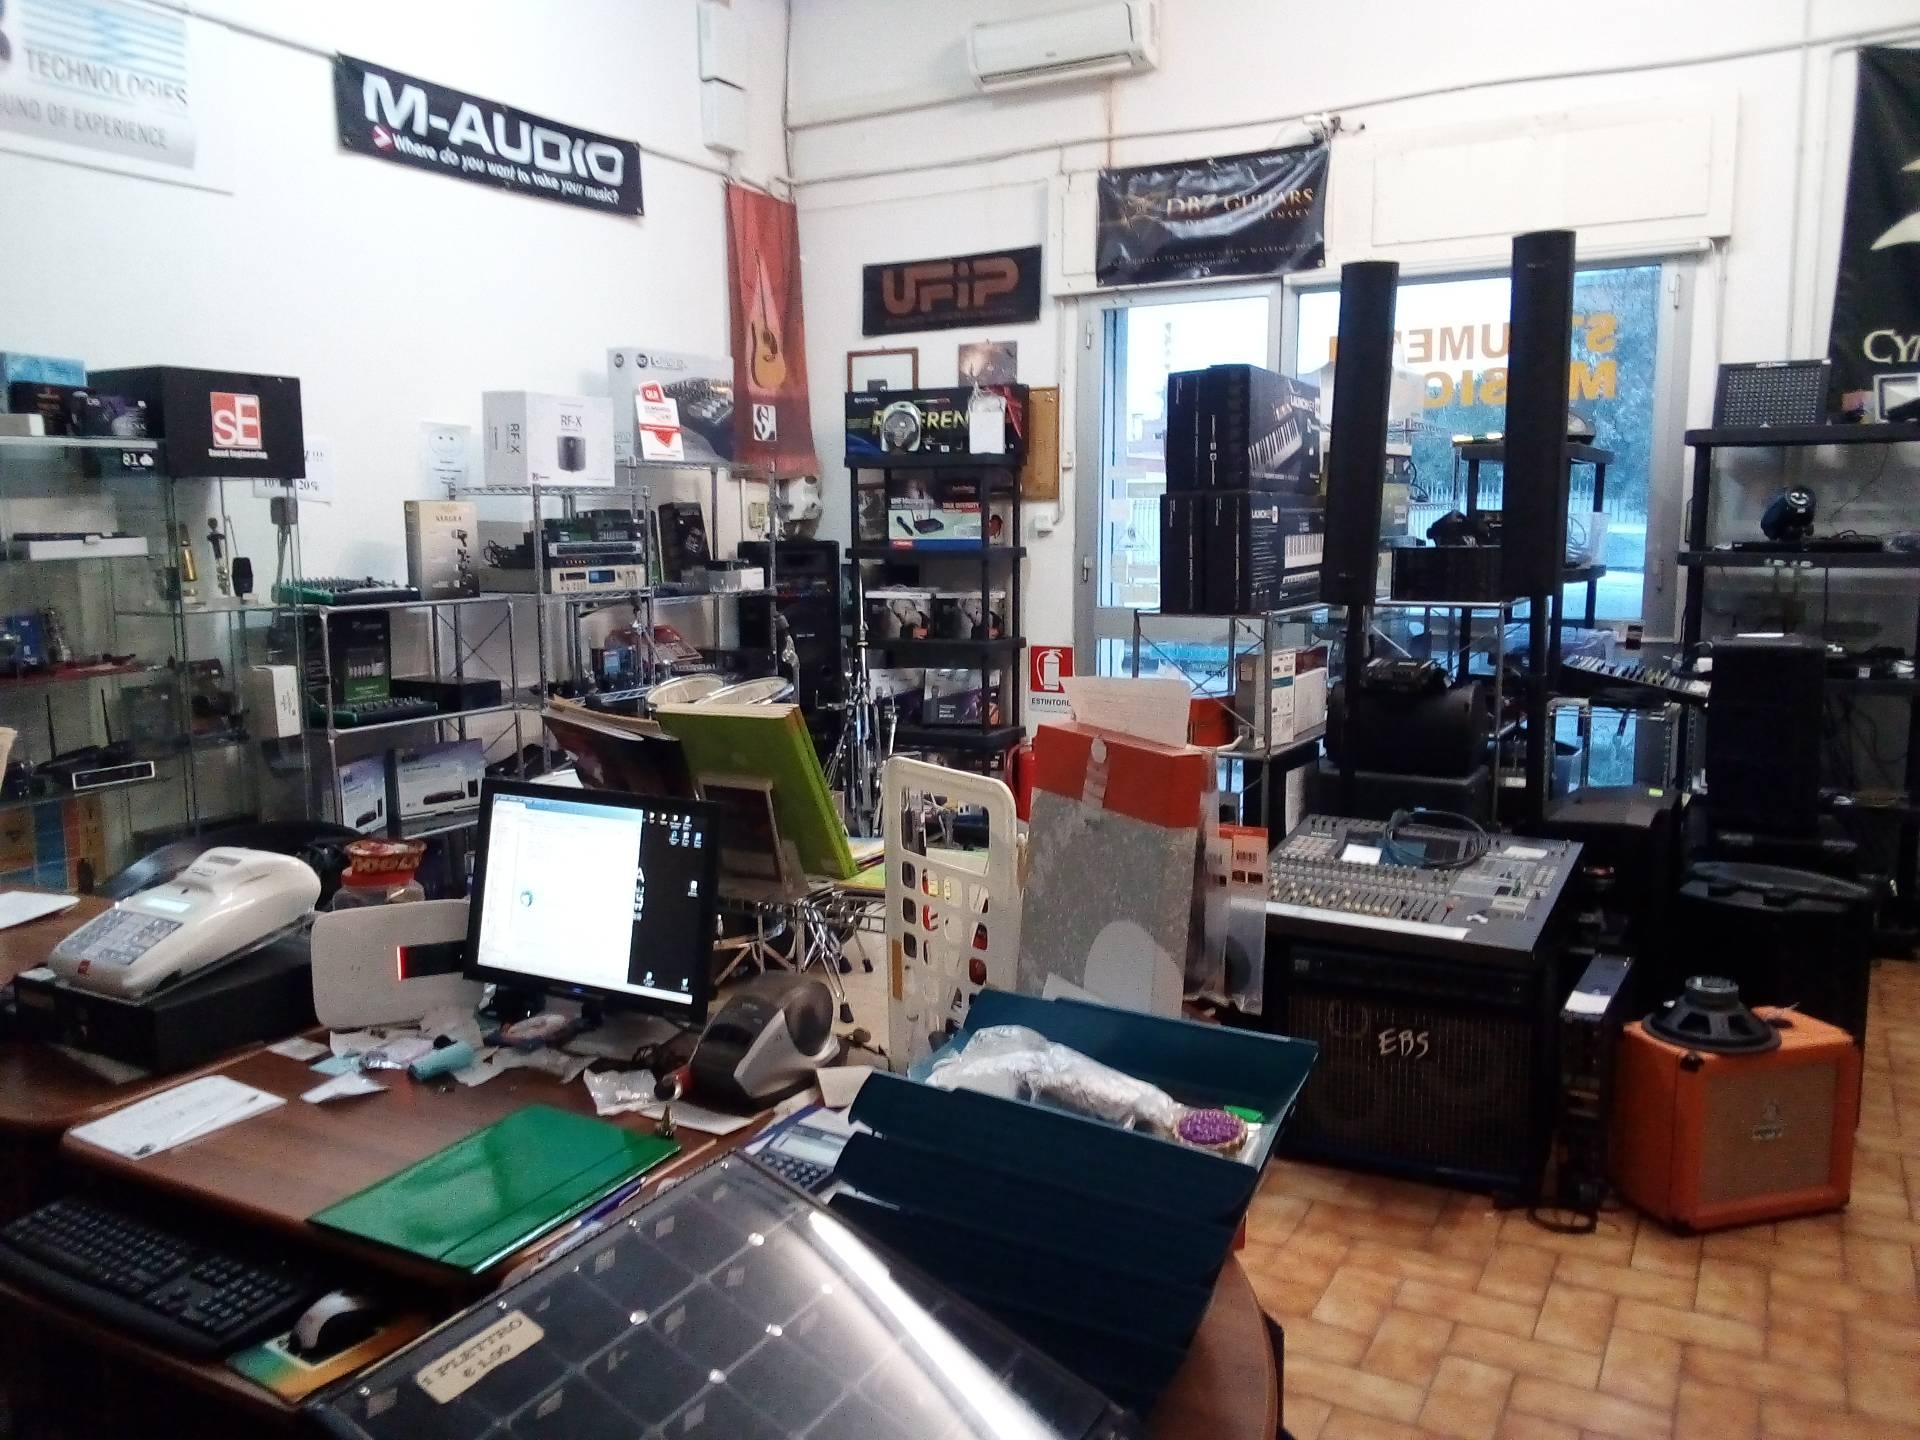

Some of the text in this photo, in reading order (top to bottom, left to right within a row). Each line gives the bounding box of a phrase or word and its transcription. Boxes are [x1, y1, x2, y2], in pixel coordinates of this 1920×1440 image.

[27, 50, 188, 105] TECHNOLOGIES
[73, 107, 168, 150] EXPERIENCE
[363, 71, 624, 187] M-AUDIO
[392, 132, 620, 205] Where do you want to take your music?
[560, 413, 583, 428] RF-X
[1379, 1028, 1429, 1059] EBS
